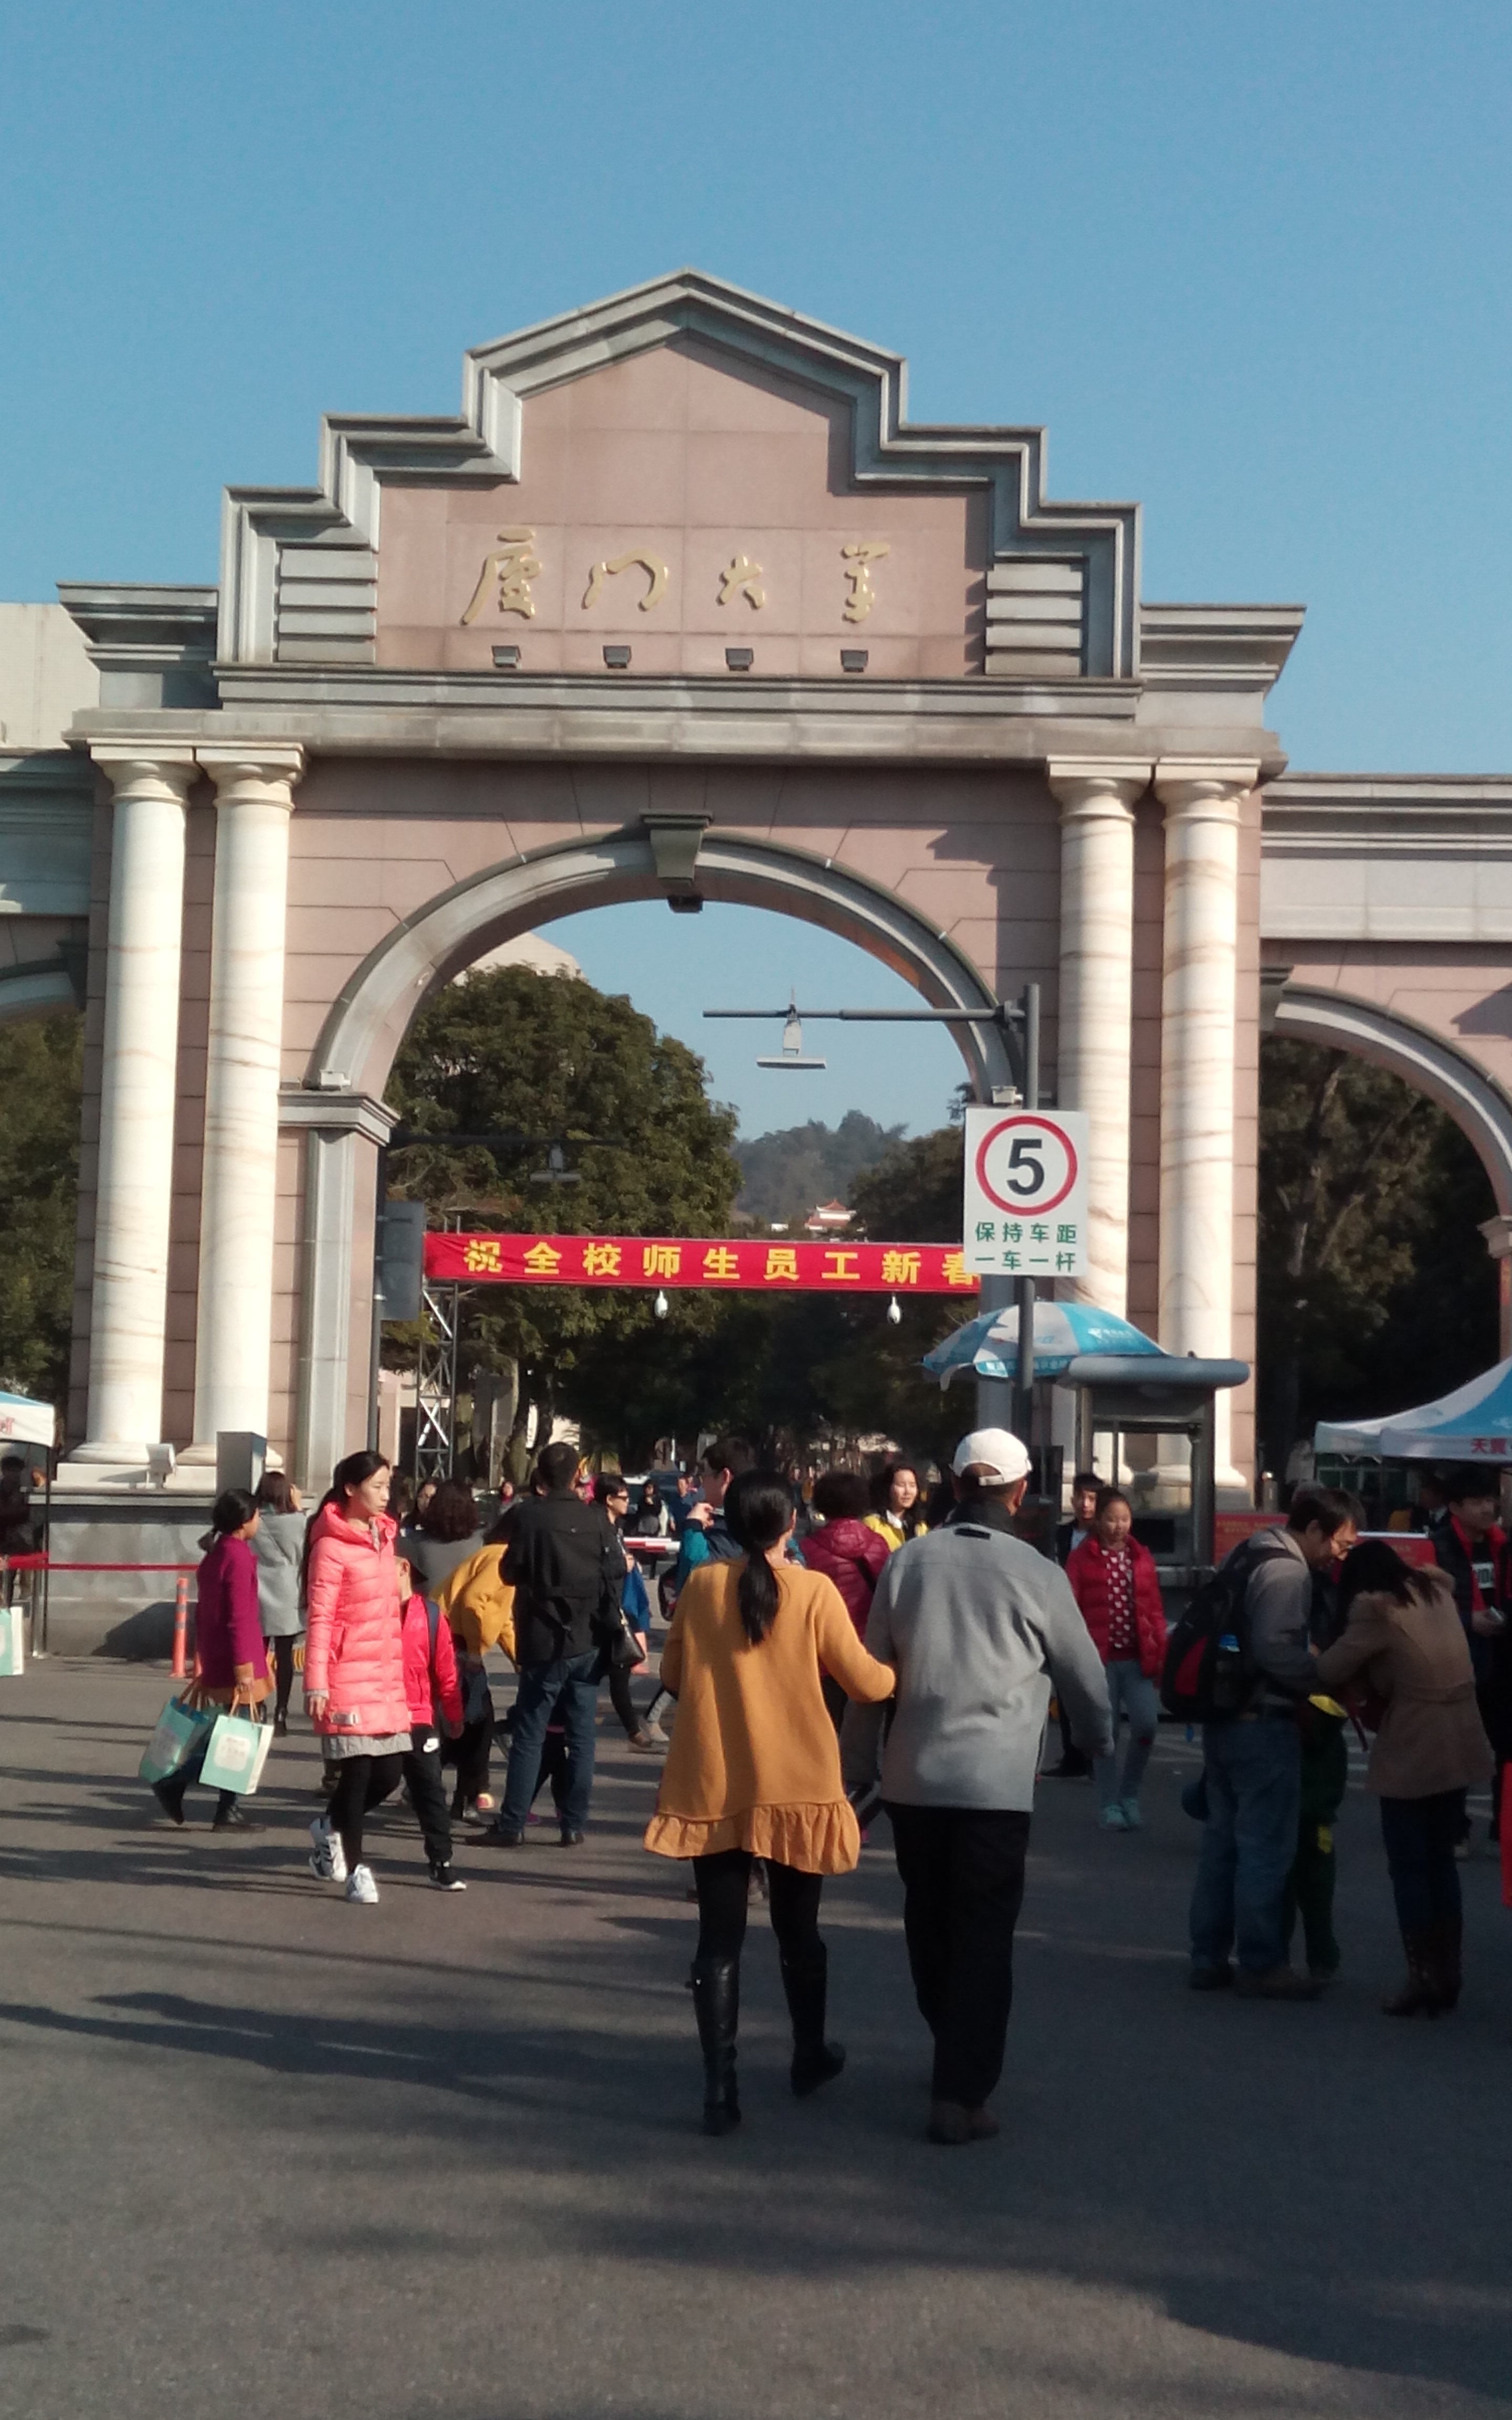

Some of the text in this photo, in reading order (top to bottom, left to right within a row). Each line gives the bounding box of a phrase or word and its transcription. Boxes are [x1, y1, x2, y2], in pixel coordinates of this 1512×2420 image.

[1006, 1139, 1045, 1195] 5
[975, 1222, 1077, 1244] 保持车距
[975, 1250, 1076, 1272] 一车一杆
